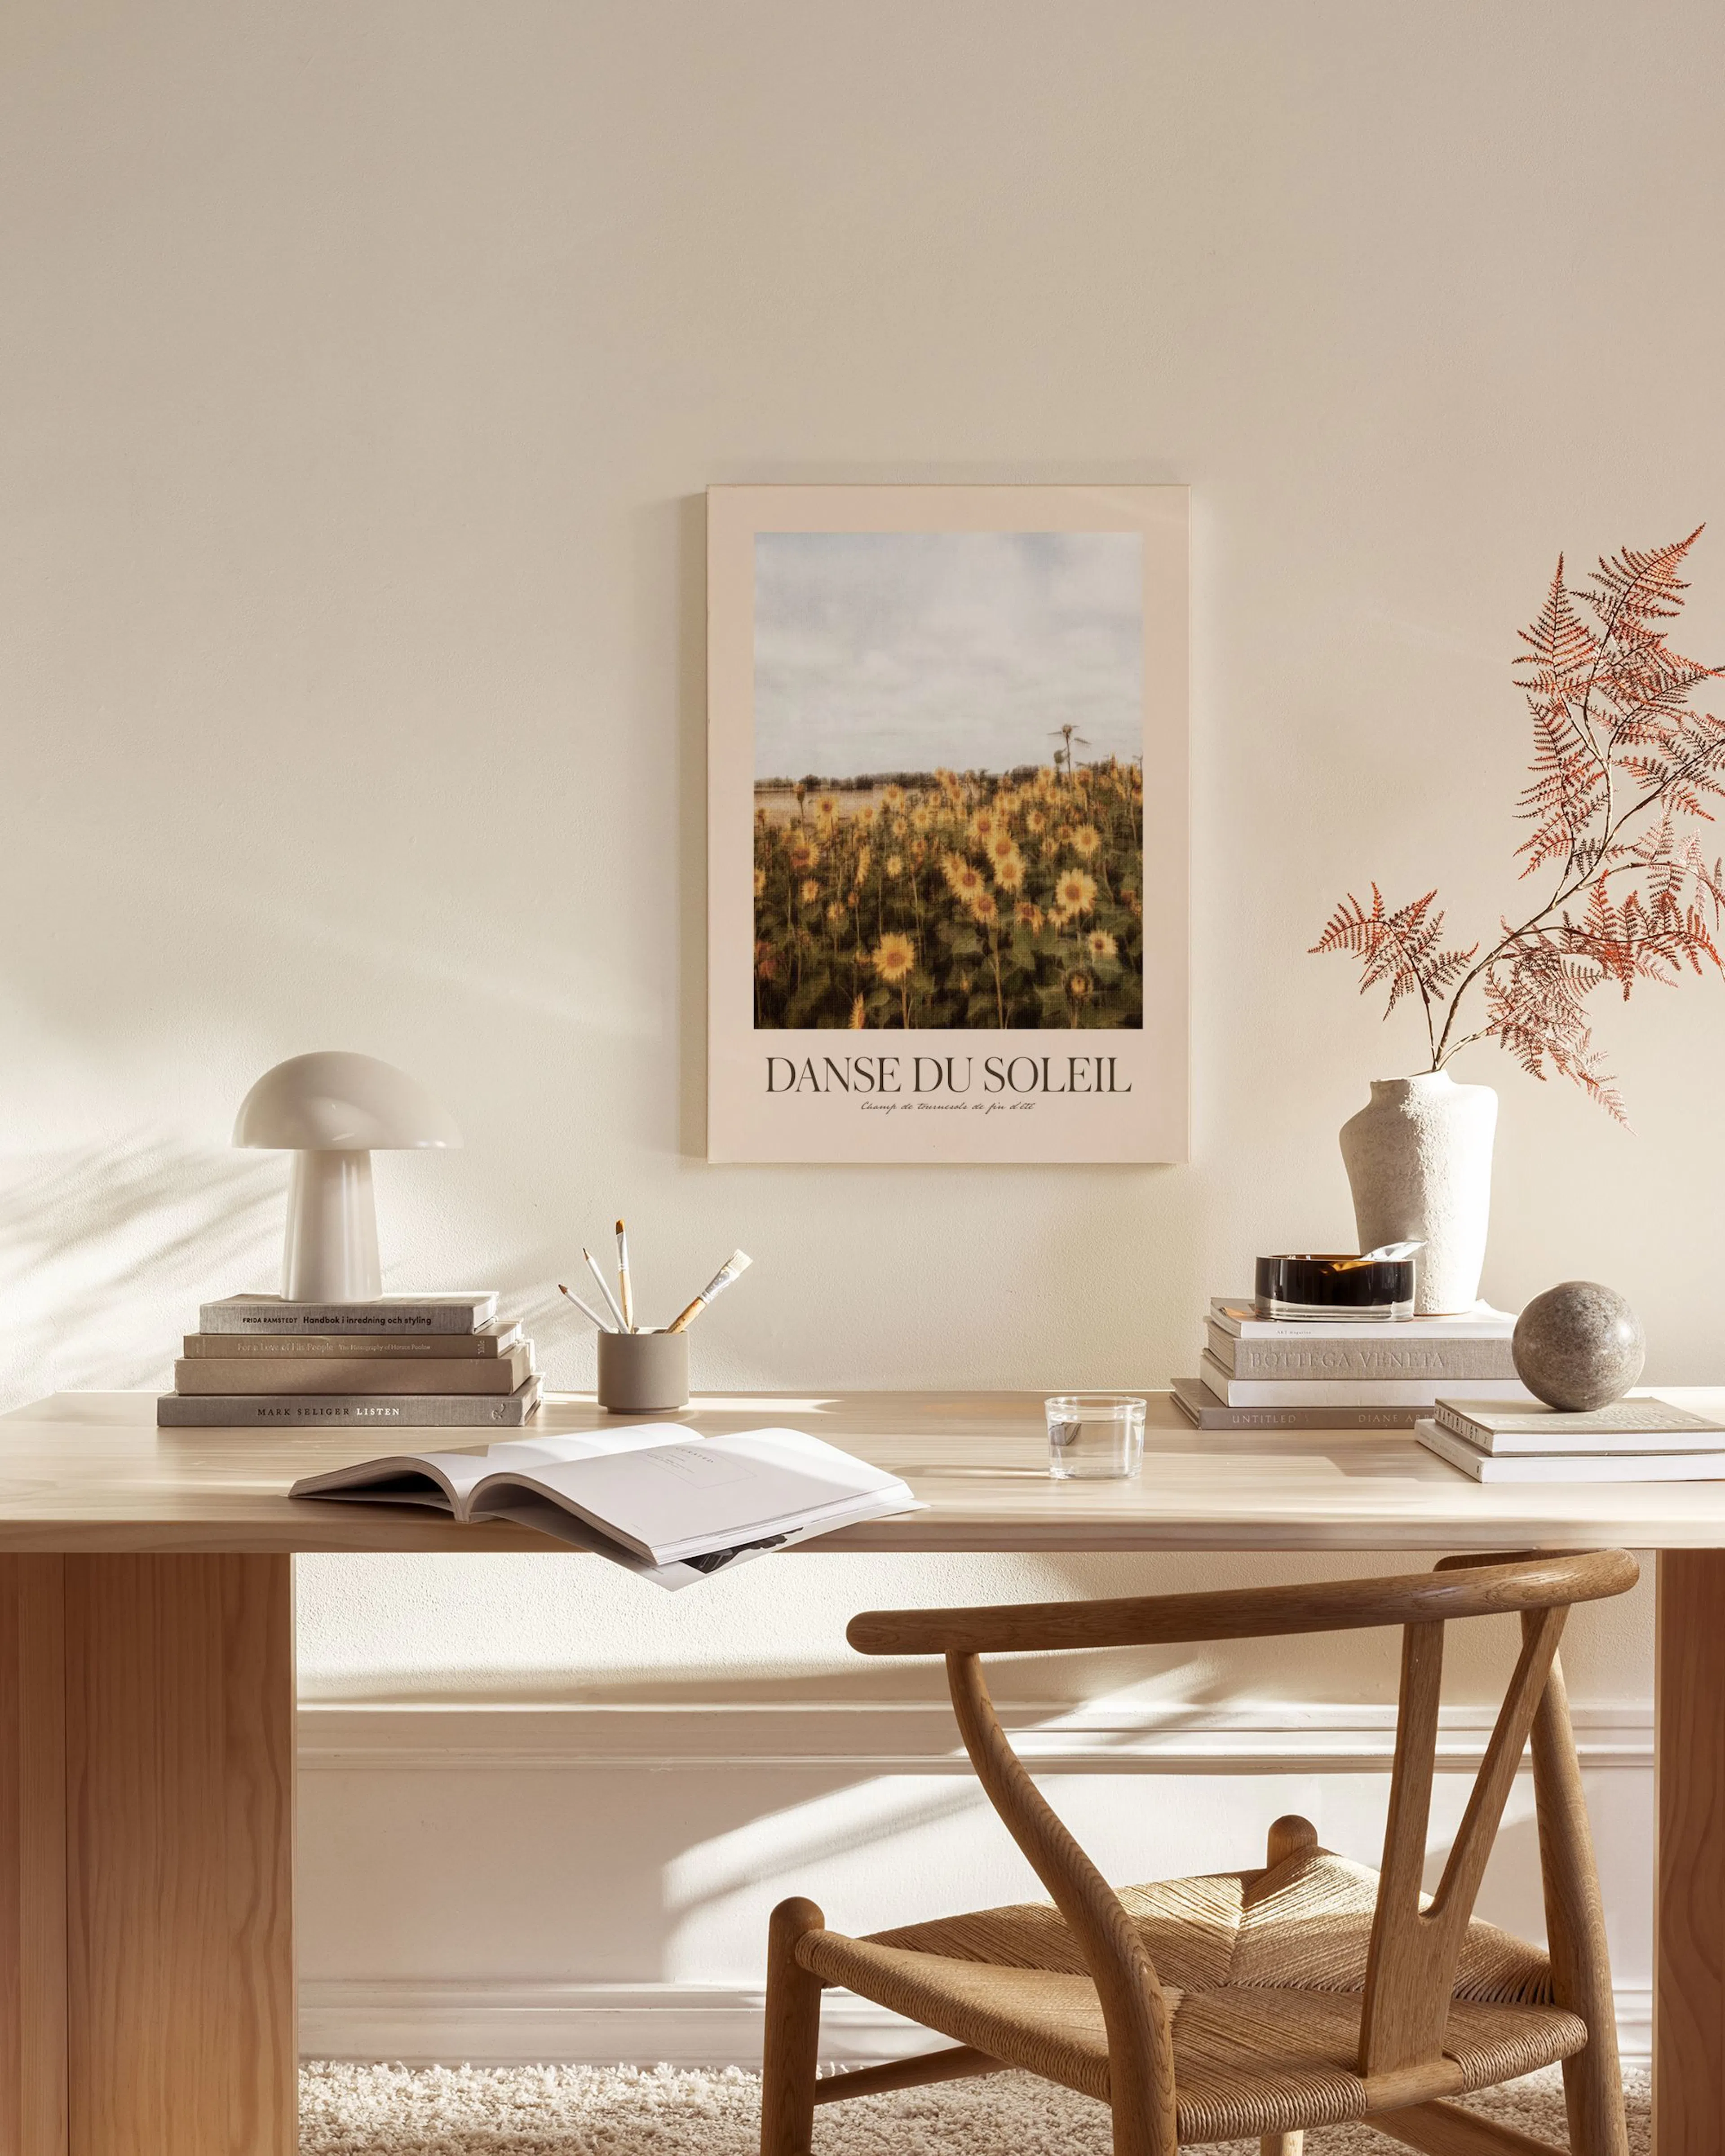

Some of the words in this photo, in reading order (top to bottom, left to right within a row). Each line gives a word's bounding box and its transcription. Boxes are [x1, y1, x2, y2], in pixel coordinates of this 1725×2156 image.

[765, 1056, 901, 1093] DANSE
[912, 1056, 973, 1093] DU
[984, 1056, 1132, 1093] SOLEIL
[861, 1101, 897, 1115] Champ
[917, 1102, 967, 1110] tournesols
[985, 1101, 1006, 1115] fin
[346, 1316, 385, 1326] inredning
[404, 1316, 431, 1326] styling
[307, 1342, 334, 1353] People
[1250, 1352, 1351, 1368] BOTTEGA
[1359, 1352, 1445, 1368] VENETA
[357, 1408, 400, 1416] LISTEN
[1232, 1414, 1296, 1423] UNTITLED
[1358, 1414, 1398, 1423] DIANE
